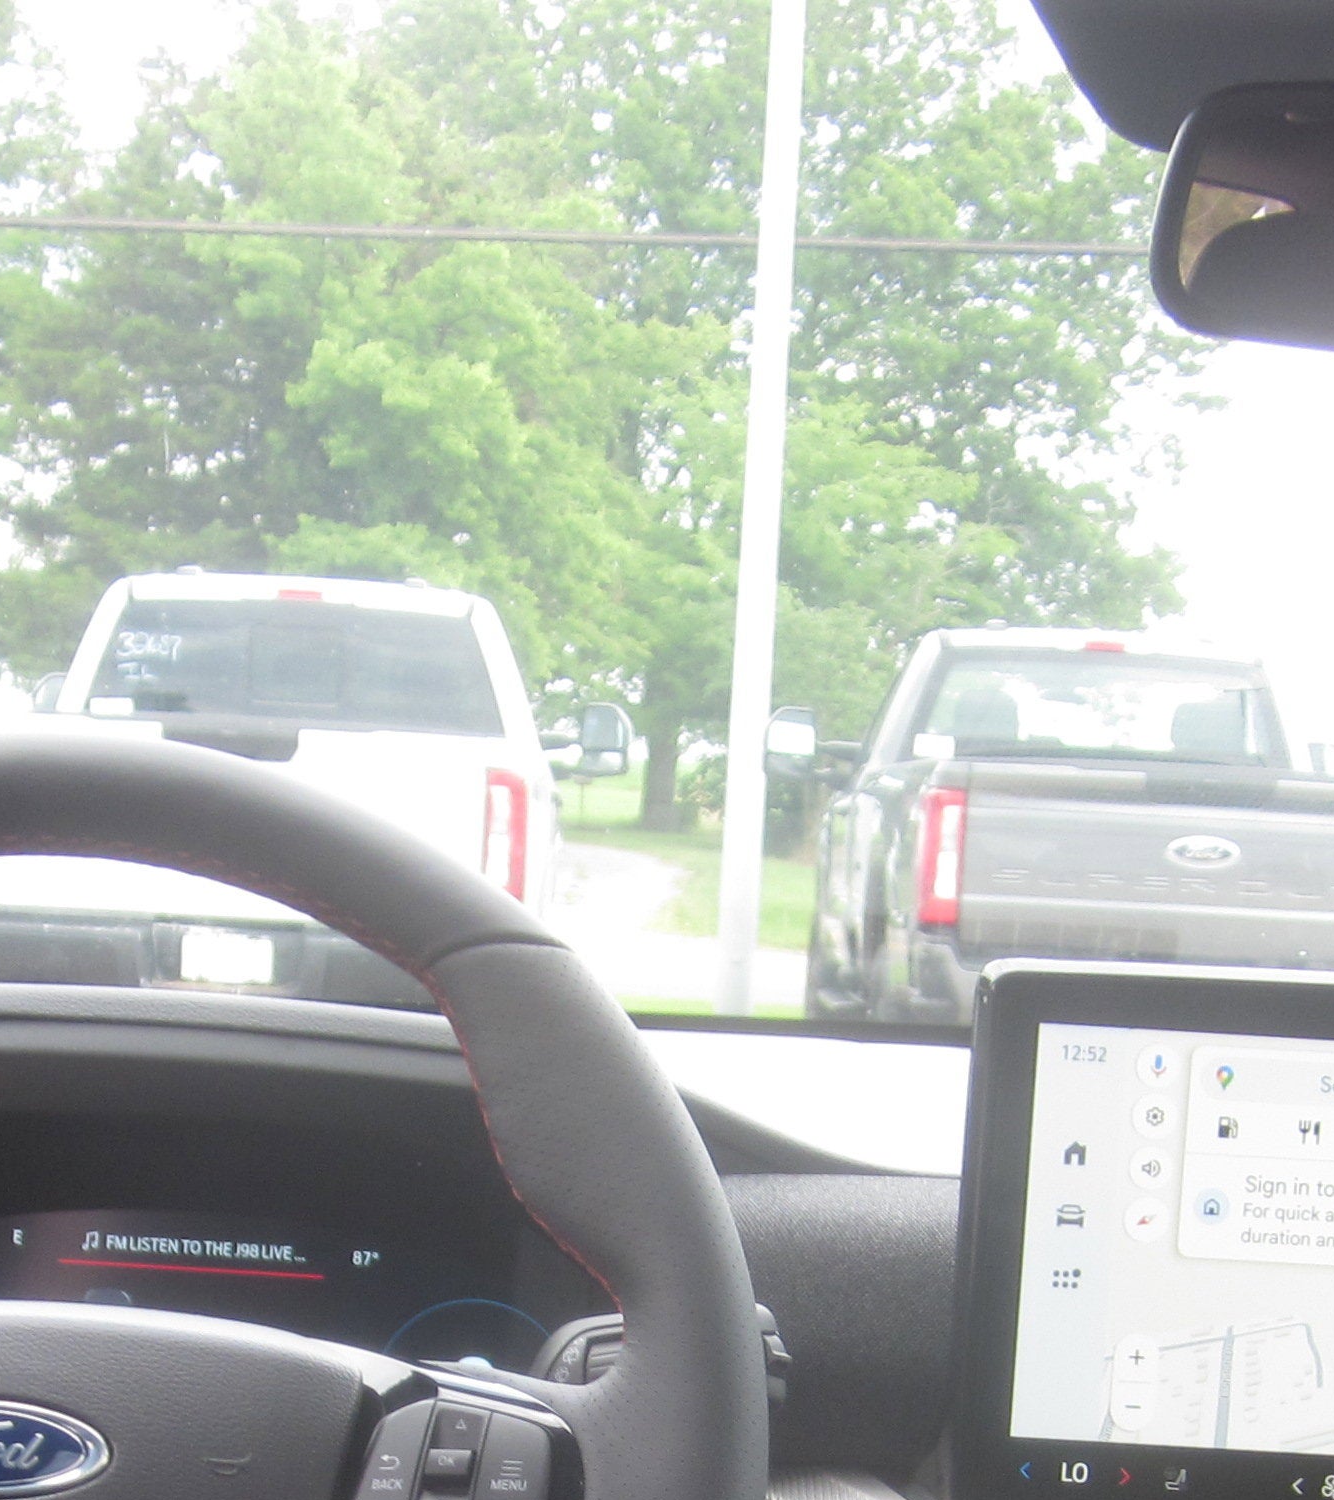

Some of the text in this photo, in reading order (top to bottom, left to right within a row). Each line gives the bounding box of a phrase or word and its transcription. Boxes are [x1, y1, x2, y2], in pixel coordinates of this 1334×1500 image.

[1061, 1044, 1108, 1063] 12:52
[1244, 1175, 1288, 1200] Sign
[1293, 1178, 1310, 1196] in
[1243, 1203, 1269, 1219] For
[1274, 1204, 1320, 1226] quick
[12, 1229, 23, 1245] E
[106, 1234, 127, 1250] FM
[129, 1236, 179, 1254] LISTEN
[181, 1238, 202, 1255] TO
[203, 1240, 232, 1257] THE
[1240, 1228, 1310, 1249] duration
[1061, 1462, 1089, 1484] LO
[371, 1479, 403, 1490] BACK
[490, 1479, 527, 1491] MENU
